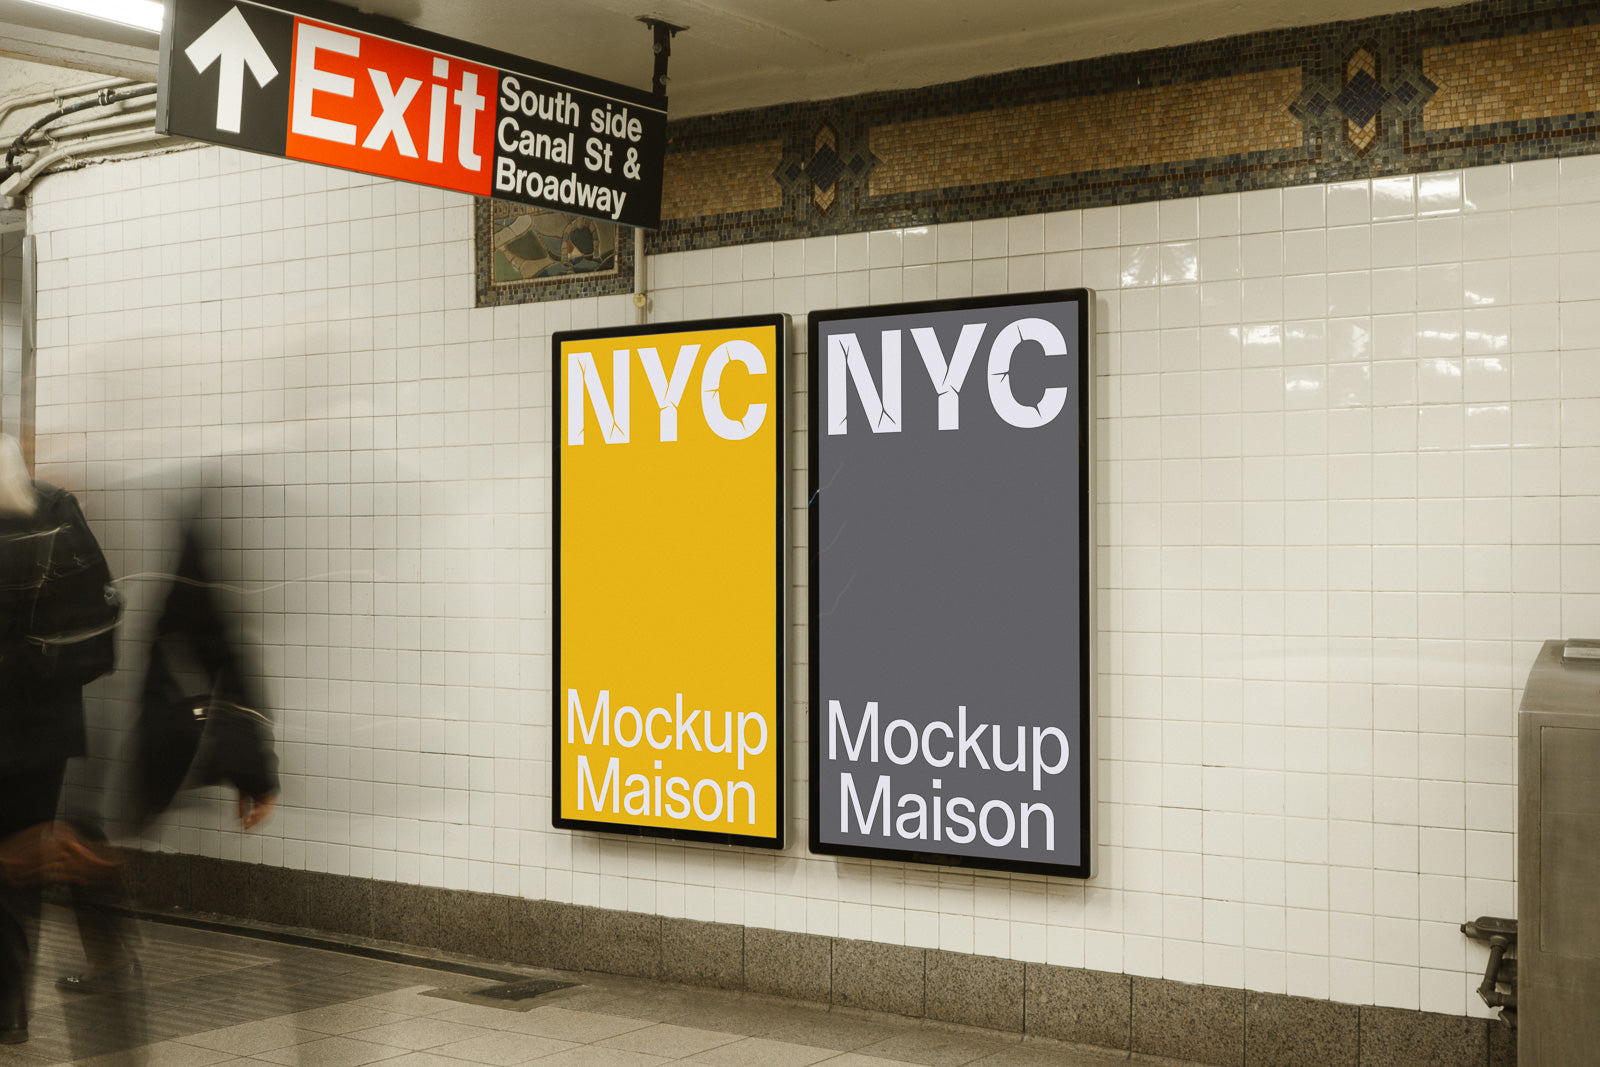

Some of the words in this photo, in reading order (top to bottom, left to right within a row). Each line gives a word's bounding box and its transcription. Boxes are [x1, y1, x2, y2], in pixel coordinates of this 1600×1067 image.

[291, 22, 485, 172] Exit
[499, 76, 579, 127] South
[590, 102, 643, 143] side
[494, 156, 627, 221] Broadway
[497, 116, 574, 165] Canal
[584, 136, 613, 174] St
[622, 146, 642, 182] &
[567, 339, 768, 446] NYC
[827, 317, 1068, 436] NYC
[567, 688, 768, 771] Mockup
[828, 699, 1070, 791] Mockup
[577, 754, 757, 825] Maison
[840, 772, 1056, 851] Maison
